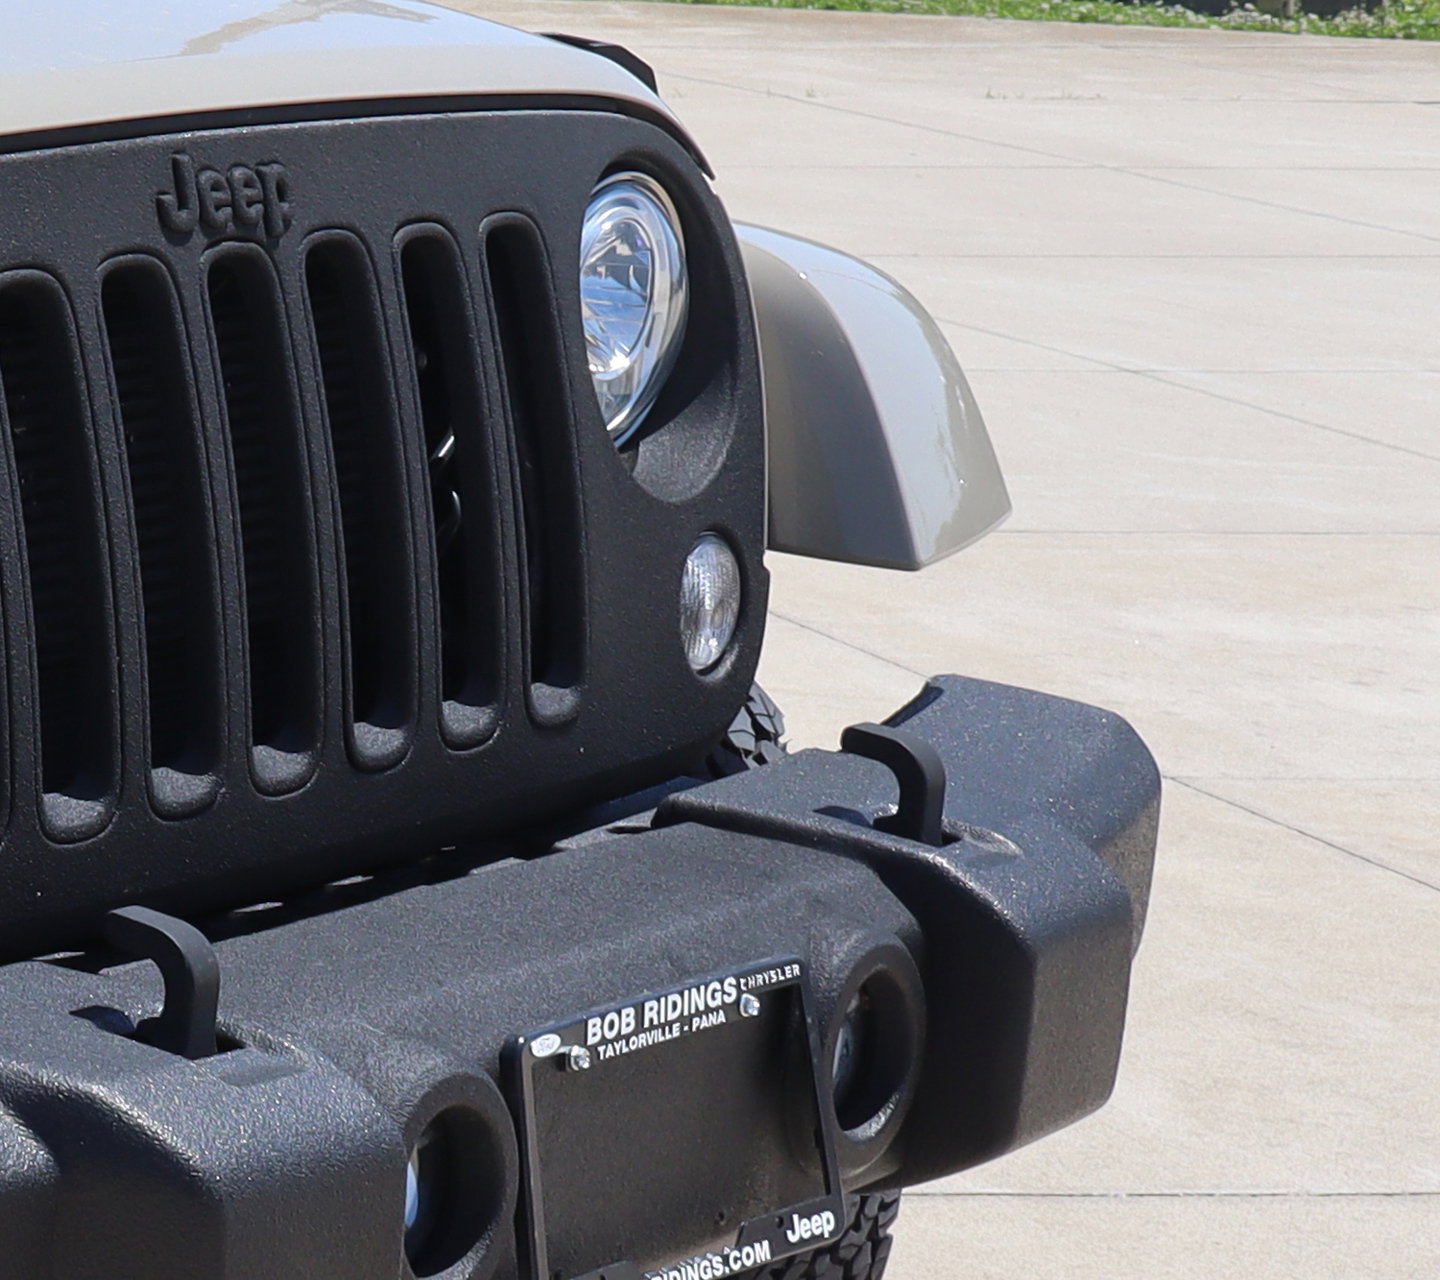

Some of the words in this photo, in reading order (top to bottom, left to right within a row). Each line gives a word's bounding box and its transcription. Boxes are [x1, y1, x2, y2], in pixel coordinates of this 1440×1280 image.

[155, 151, 294, 241] Jeep
[739, 964, 801, 991] CHRYSLER
[586, 1005, 637, 1045] BOB
[642, 976, 738, 1029] RIDINGS
[596, 1024, 681, 1061] TAYLORVILLE
[692, 1010, 727, 1035] PANA
[786, 1209, 836, 1245] Jeep
